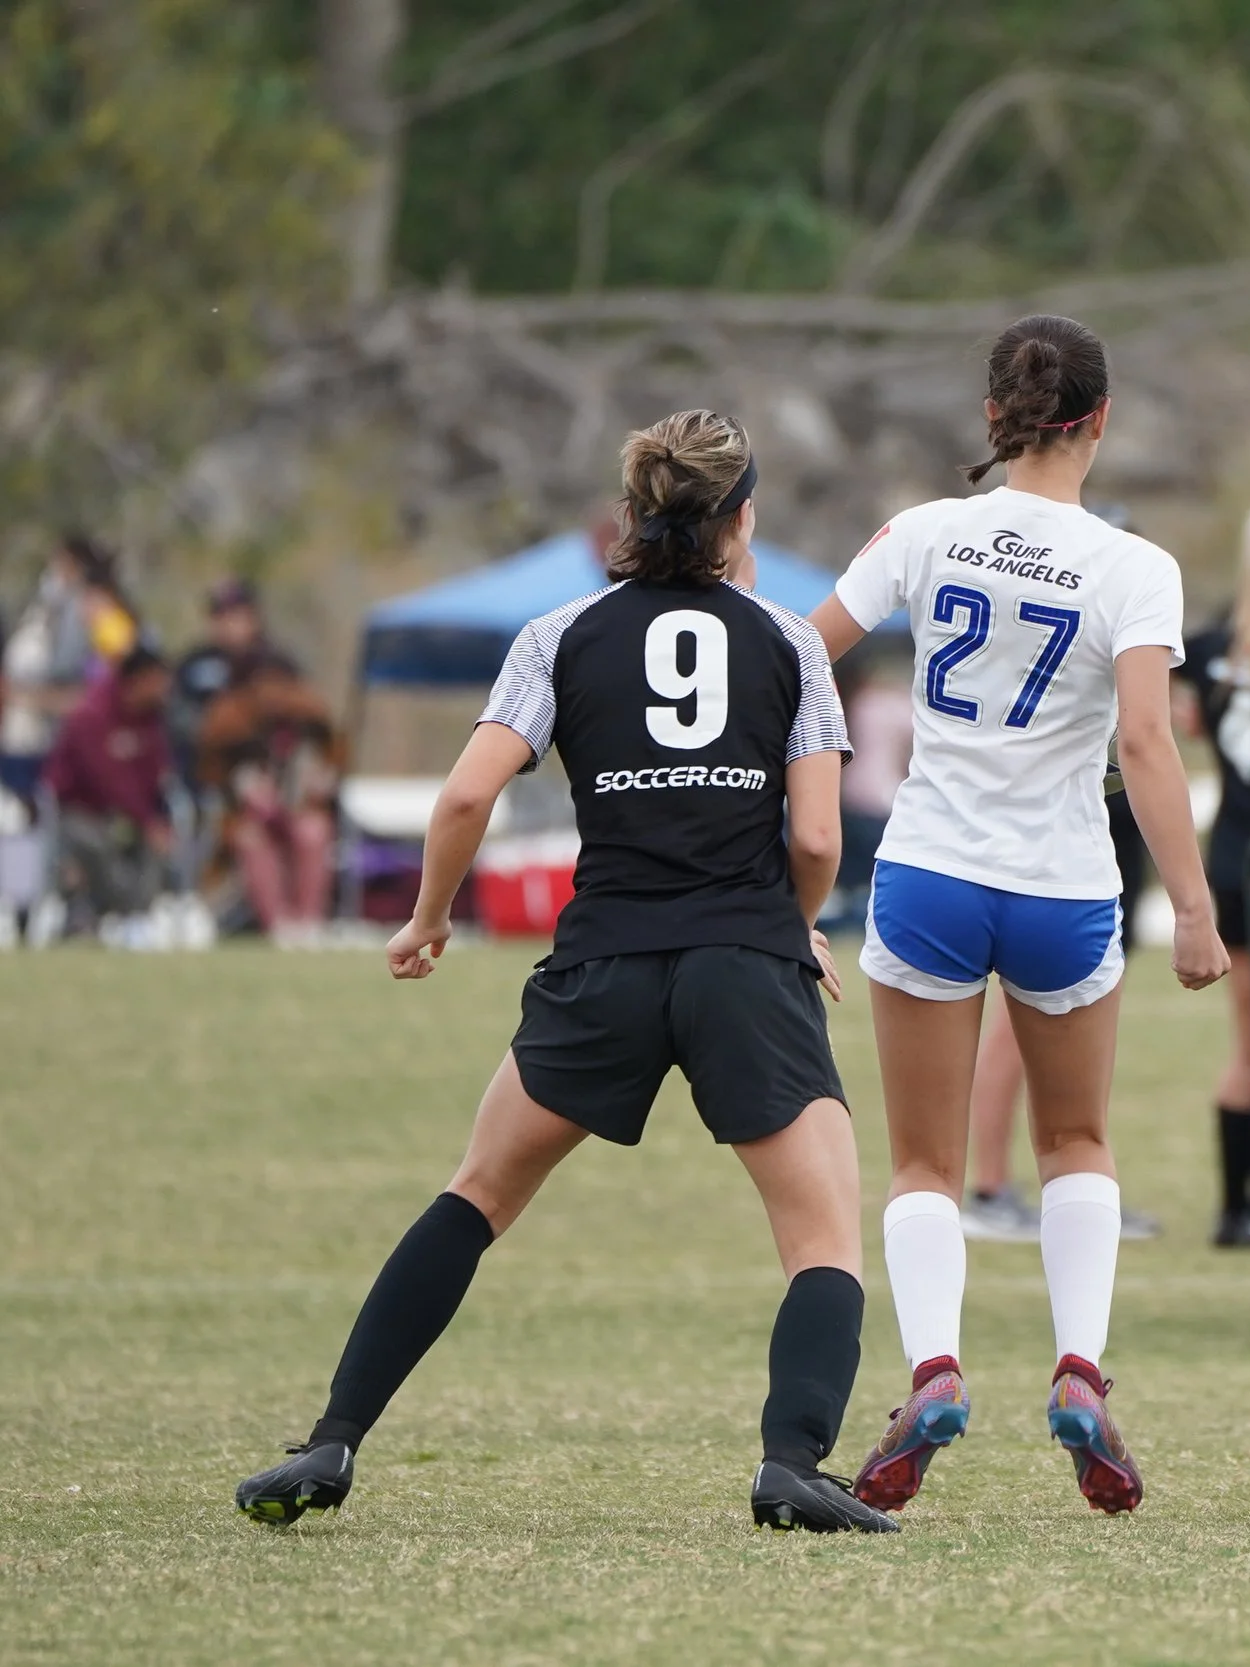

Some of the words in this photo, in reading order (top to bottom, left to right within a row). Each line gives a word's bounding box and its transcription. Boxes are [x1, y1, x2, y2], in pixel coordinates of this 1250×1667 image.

[946, 543, 989, 567] LOS
[986, 557, 1082, 590] ANGELES
[1004, 541, 1053, 561] SURF
[645, 609, 728, 749] 9
[925, 582, 1083, 731] 27
[594, 765, 767, 793] SOCCER.COM
